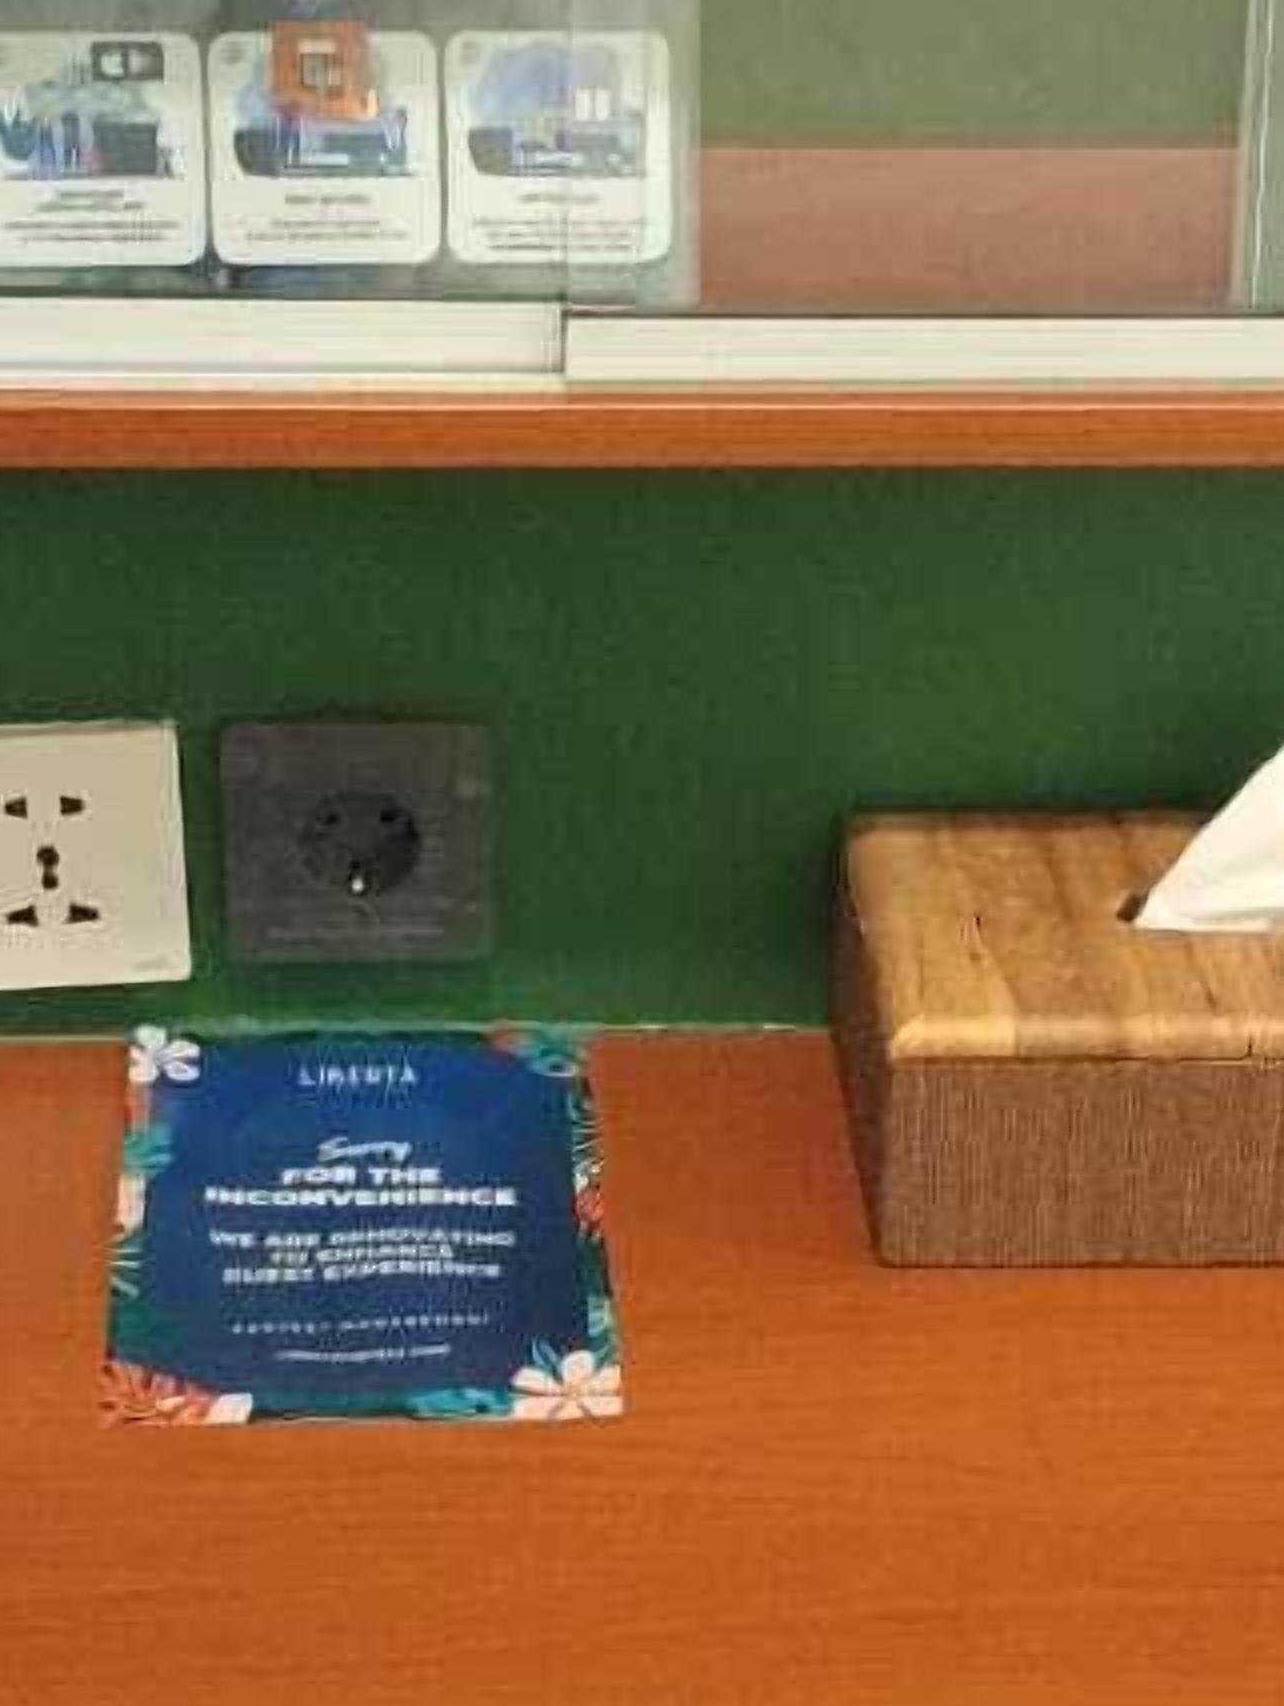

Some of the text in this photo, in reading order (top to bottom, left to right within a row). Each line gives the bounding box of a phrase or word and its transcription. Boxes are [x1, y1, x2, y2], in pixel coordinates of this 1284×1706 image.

[296, 1063, 419, 1088] LIBERTA
[281, 1166, 442, 1186] FOR THE
[204, 1185, 518, 1208] INCONVENIENCE
[209, 1227, 516, 1248] WE ARE RENOVATING
[321, 1260, 505, 1284] EXPERIENCE
